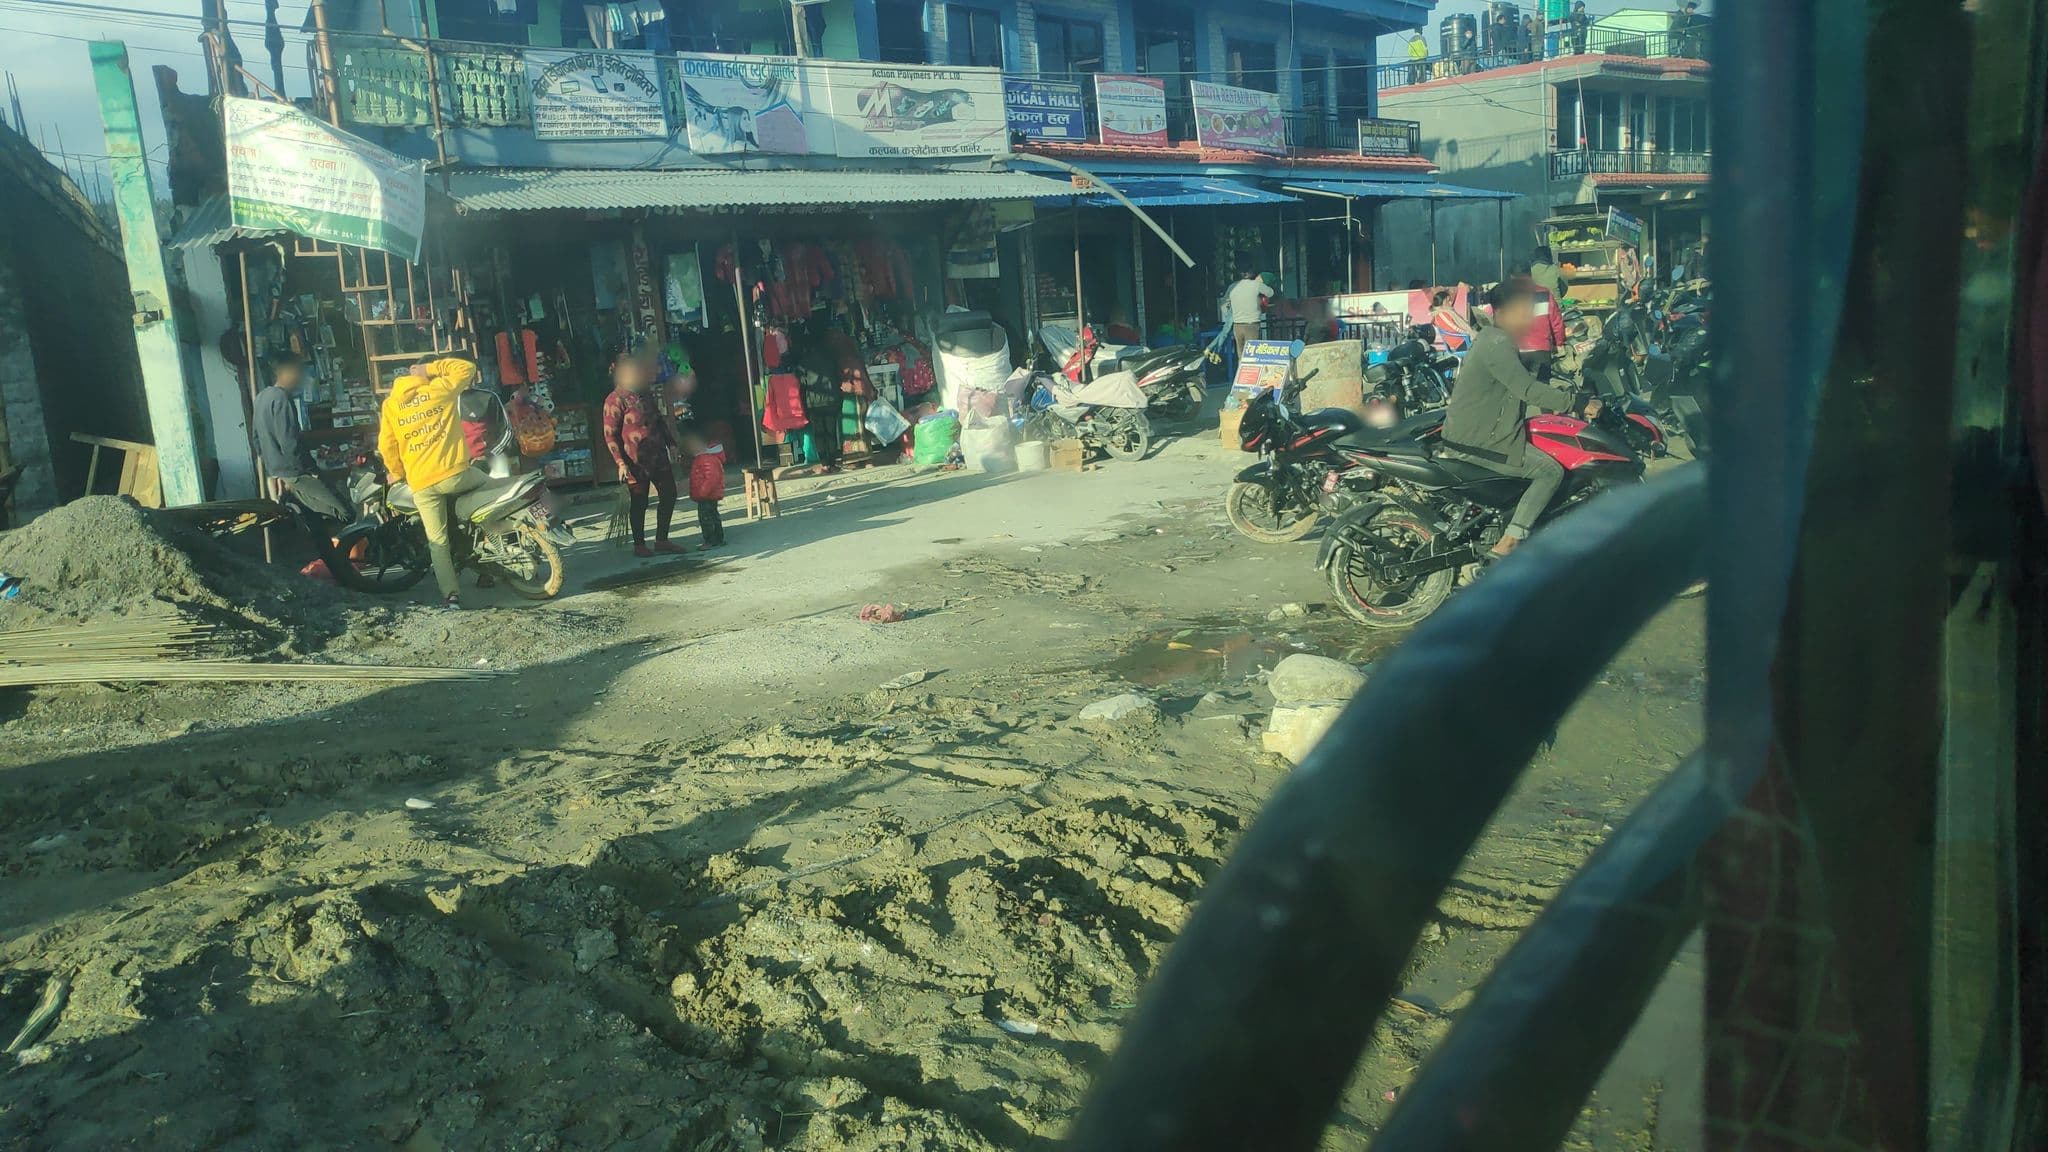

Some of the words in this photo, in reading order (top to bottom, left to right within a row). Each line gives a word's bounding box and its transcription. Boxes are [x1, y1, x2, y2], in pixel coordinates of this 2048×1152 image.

[872, 69, 895, 79] Action
[897, 70, 931, 81] Polymers
[1006, 90, 1045, 106] DICAL
[1048, 94, 1080, 108] HALL
[397, 404, 444, 427] business
